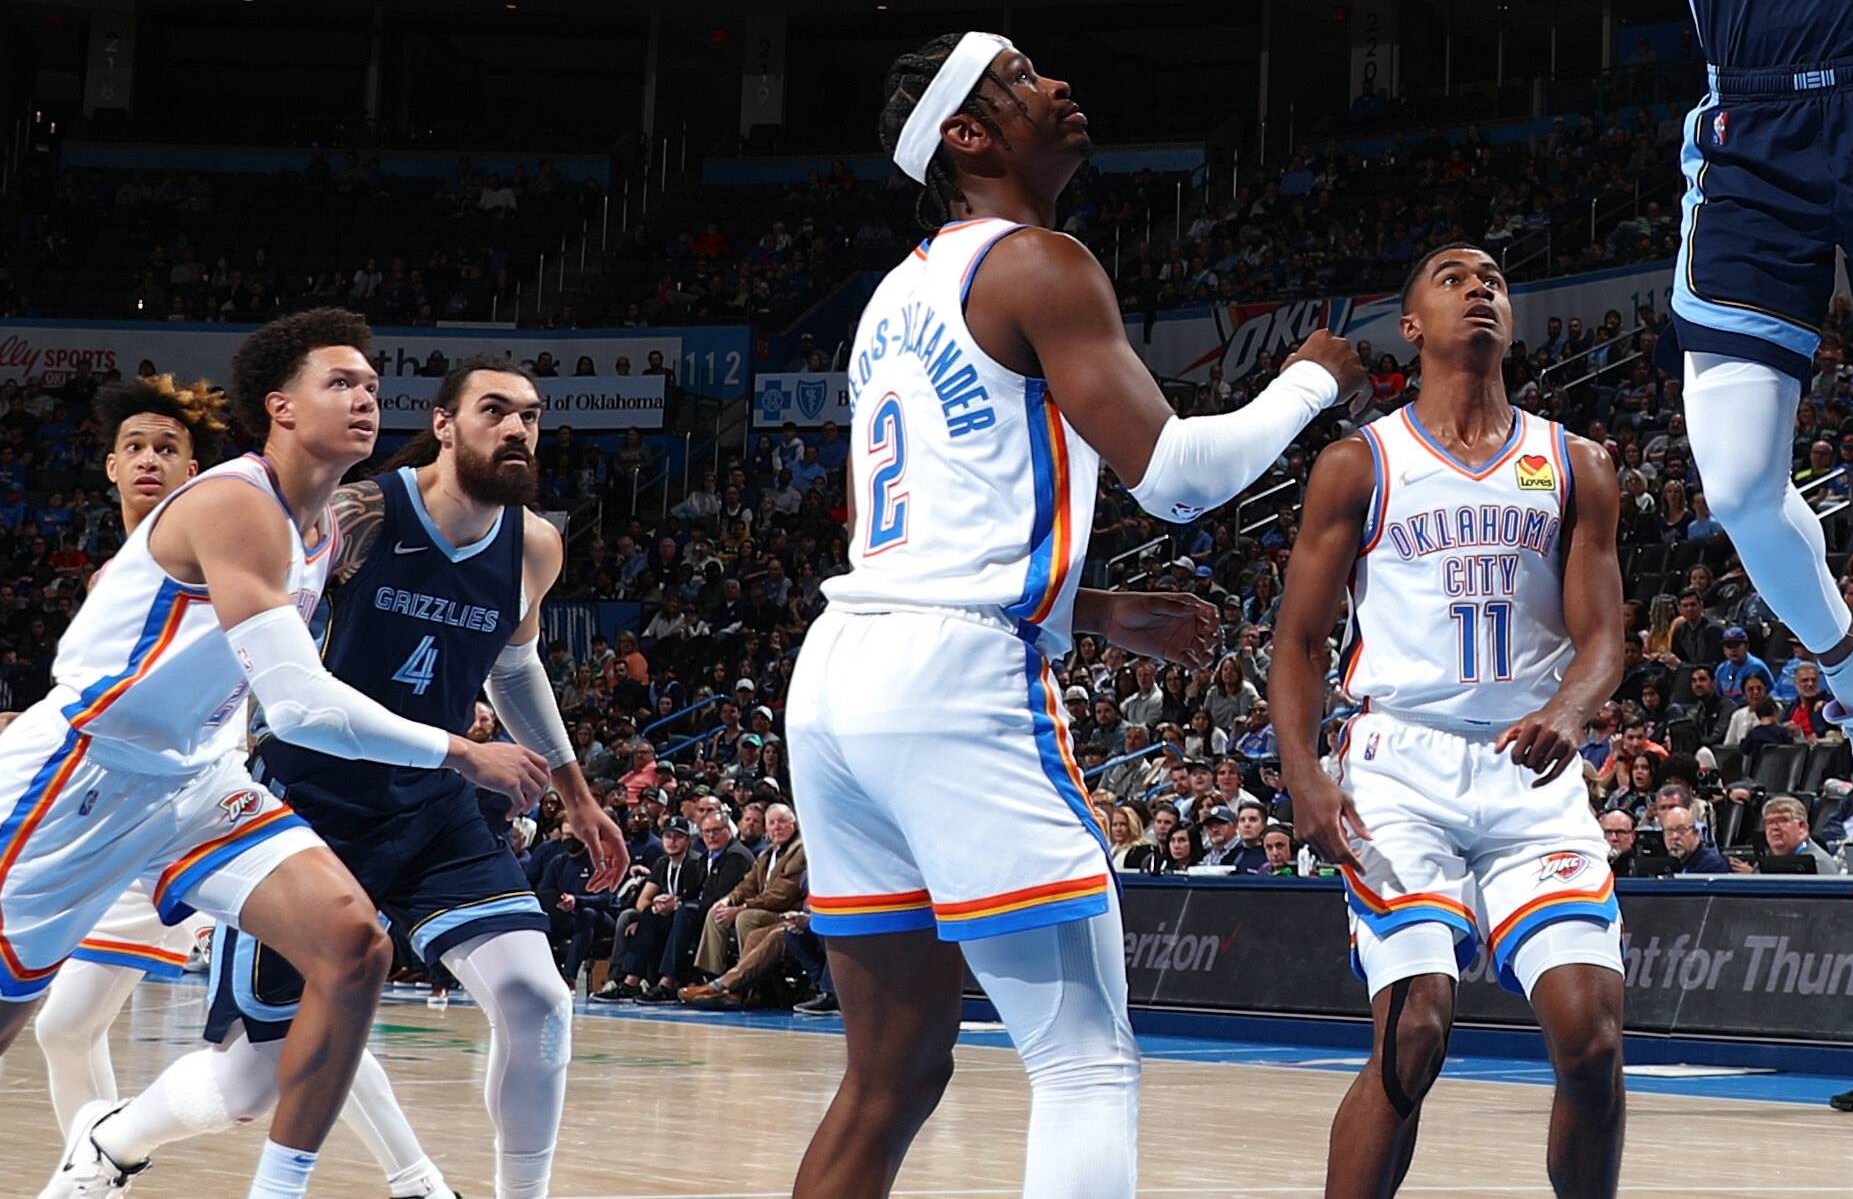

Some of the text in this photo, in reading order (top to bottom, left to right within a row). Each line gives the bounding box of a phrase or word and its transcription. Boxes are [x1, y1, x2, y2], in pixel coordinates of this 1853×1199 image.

[45, 349, 116, 369] SPORTS
[685, 351, 741, 386] 112
[576, 393, 665, 410] Oklahoma
[863, 391, 910, 559] 2
[1388, 504, 1561, 562] OKLAHOMA
[1441, 554, 1519, 597] CITY
[375, 586, 499, 633] GRIZZLIES
[391, 635, 439, 696] 4
[1450, 601, 1512, 684] 11
[1124, 922, 1221, 972] erizon
[1662, 933, 1733, 990] for
